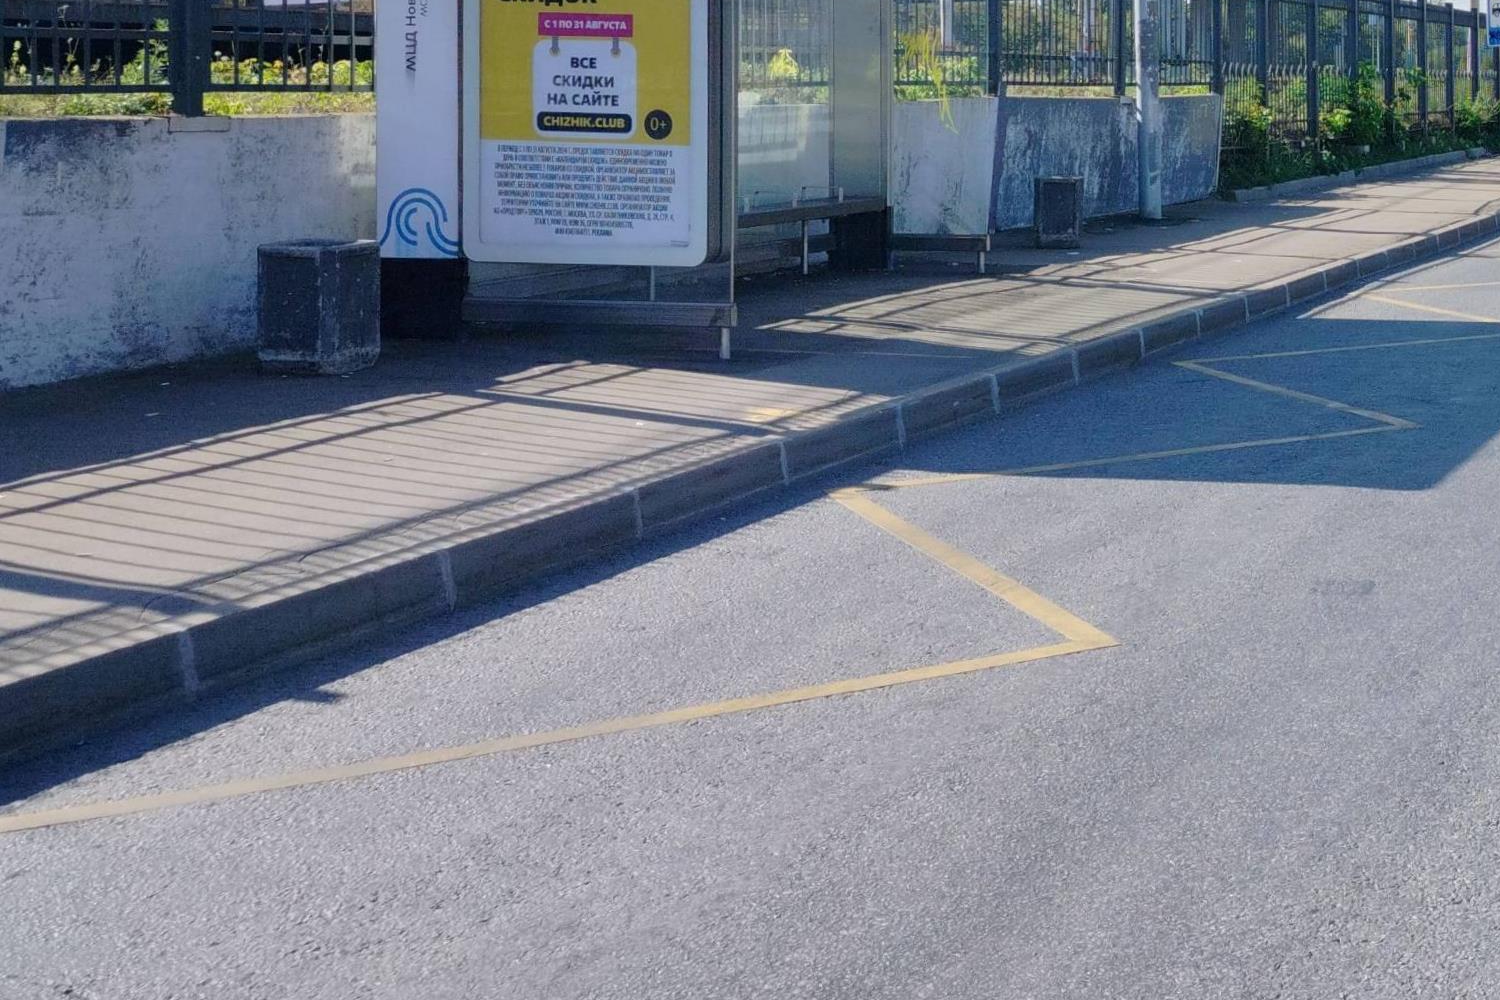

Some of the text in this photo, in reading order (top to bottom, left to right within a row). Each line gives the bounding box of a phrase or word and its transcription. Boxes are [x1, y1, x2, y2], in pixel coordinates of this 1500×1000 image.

[544, 21, 552, 29] С
[558, 21, 573, 29] ПО
[574, 21, 585, 29] 31
[586, 21, 627, 30] АВГУСТА
[570, 57, 597, 69] ВСЕ
[552, 74, 615, 89] СКИДКИ
[547, 90, 620, 107] НА САЙТЕ
[543, 115, 626, 129] CHIZHIK.CLUB
[649, 117, 668, 131] 0+
